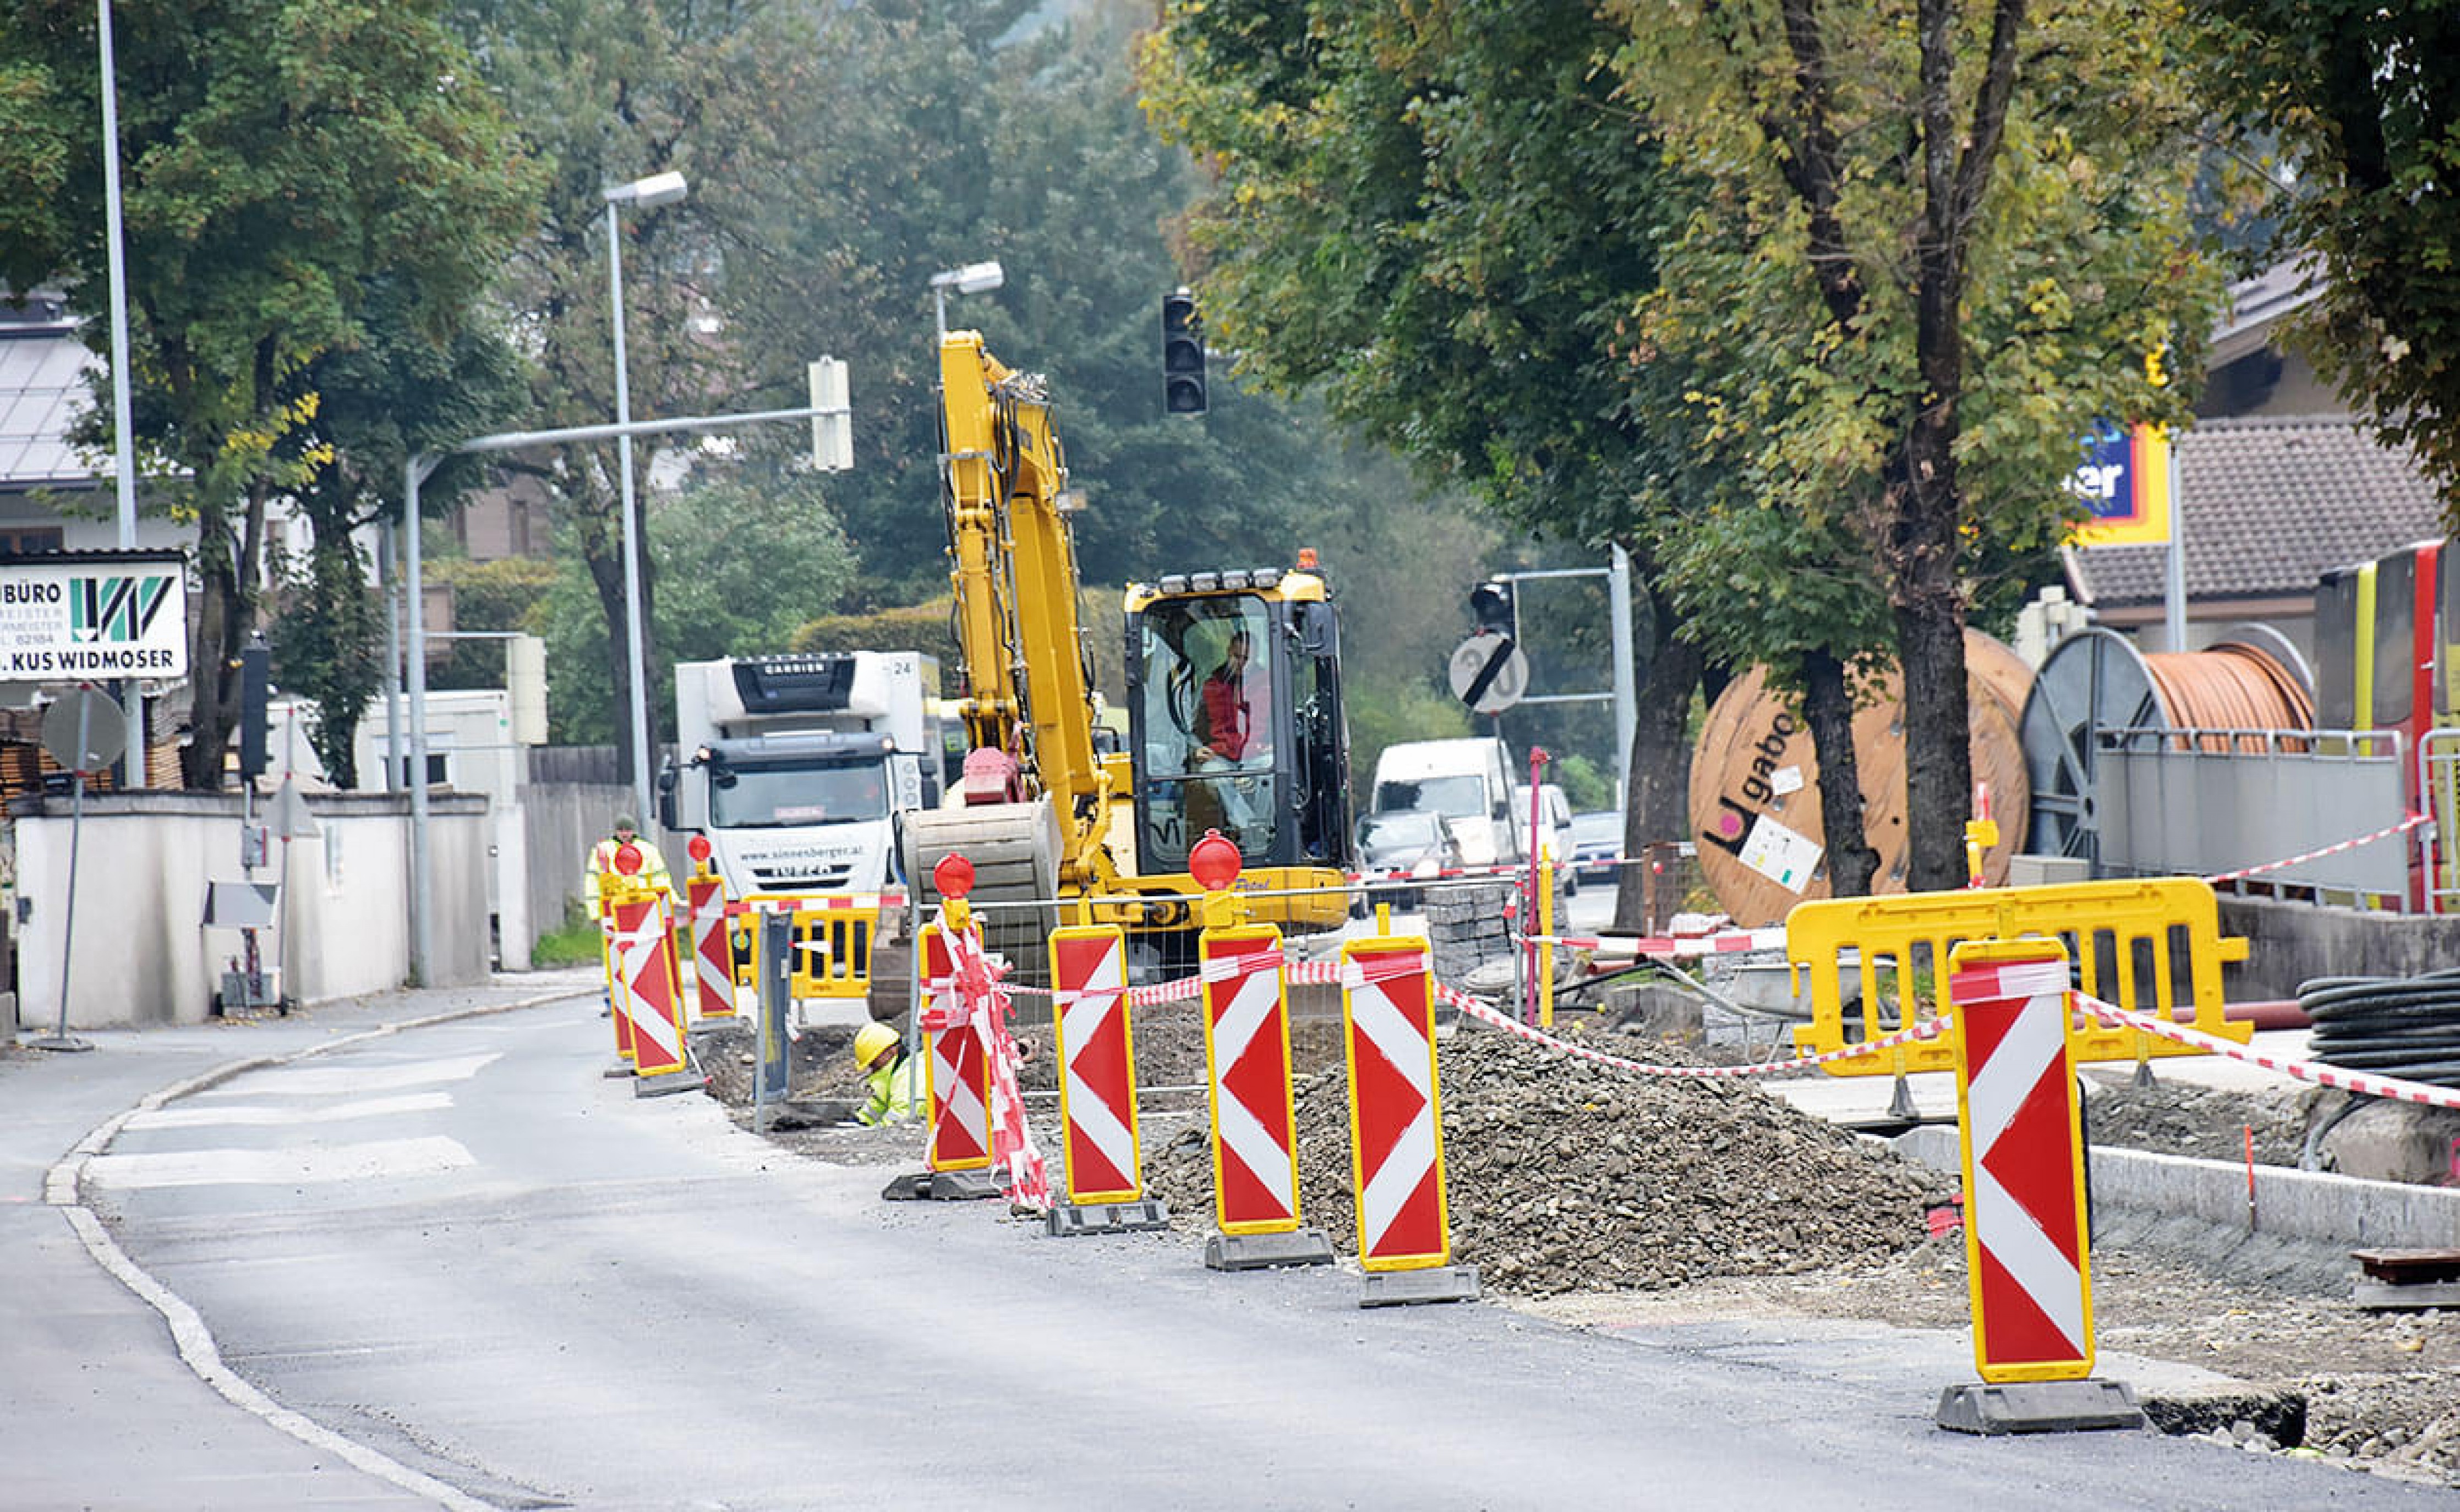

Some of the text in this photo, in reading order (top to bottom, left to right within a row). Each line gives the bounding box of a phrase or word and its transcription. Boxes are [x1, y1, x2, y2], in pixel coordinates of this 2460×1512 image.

[0, 578, 62, 604] BÜRO
[57, 650, 173, 670] WIDMOSER
[1742, 712, 1796, 804] gabo
